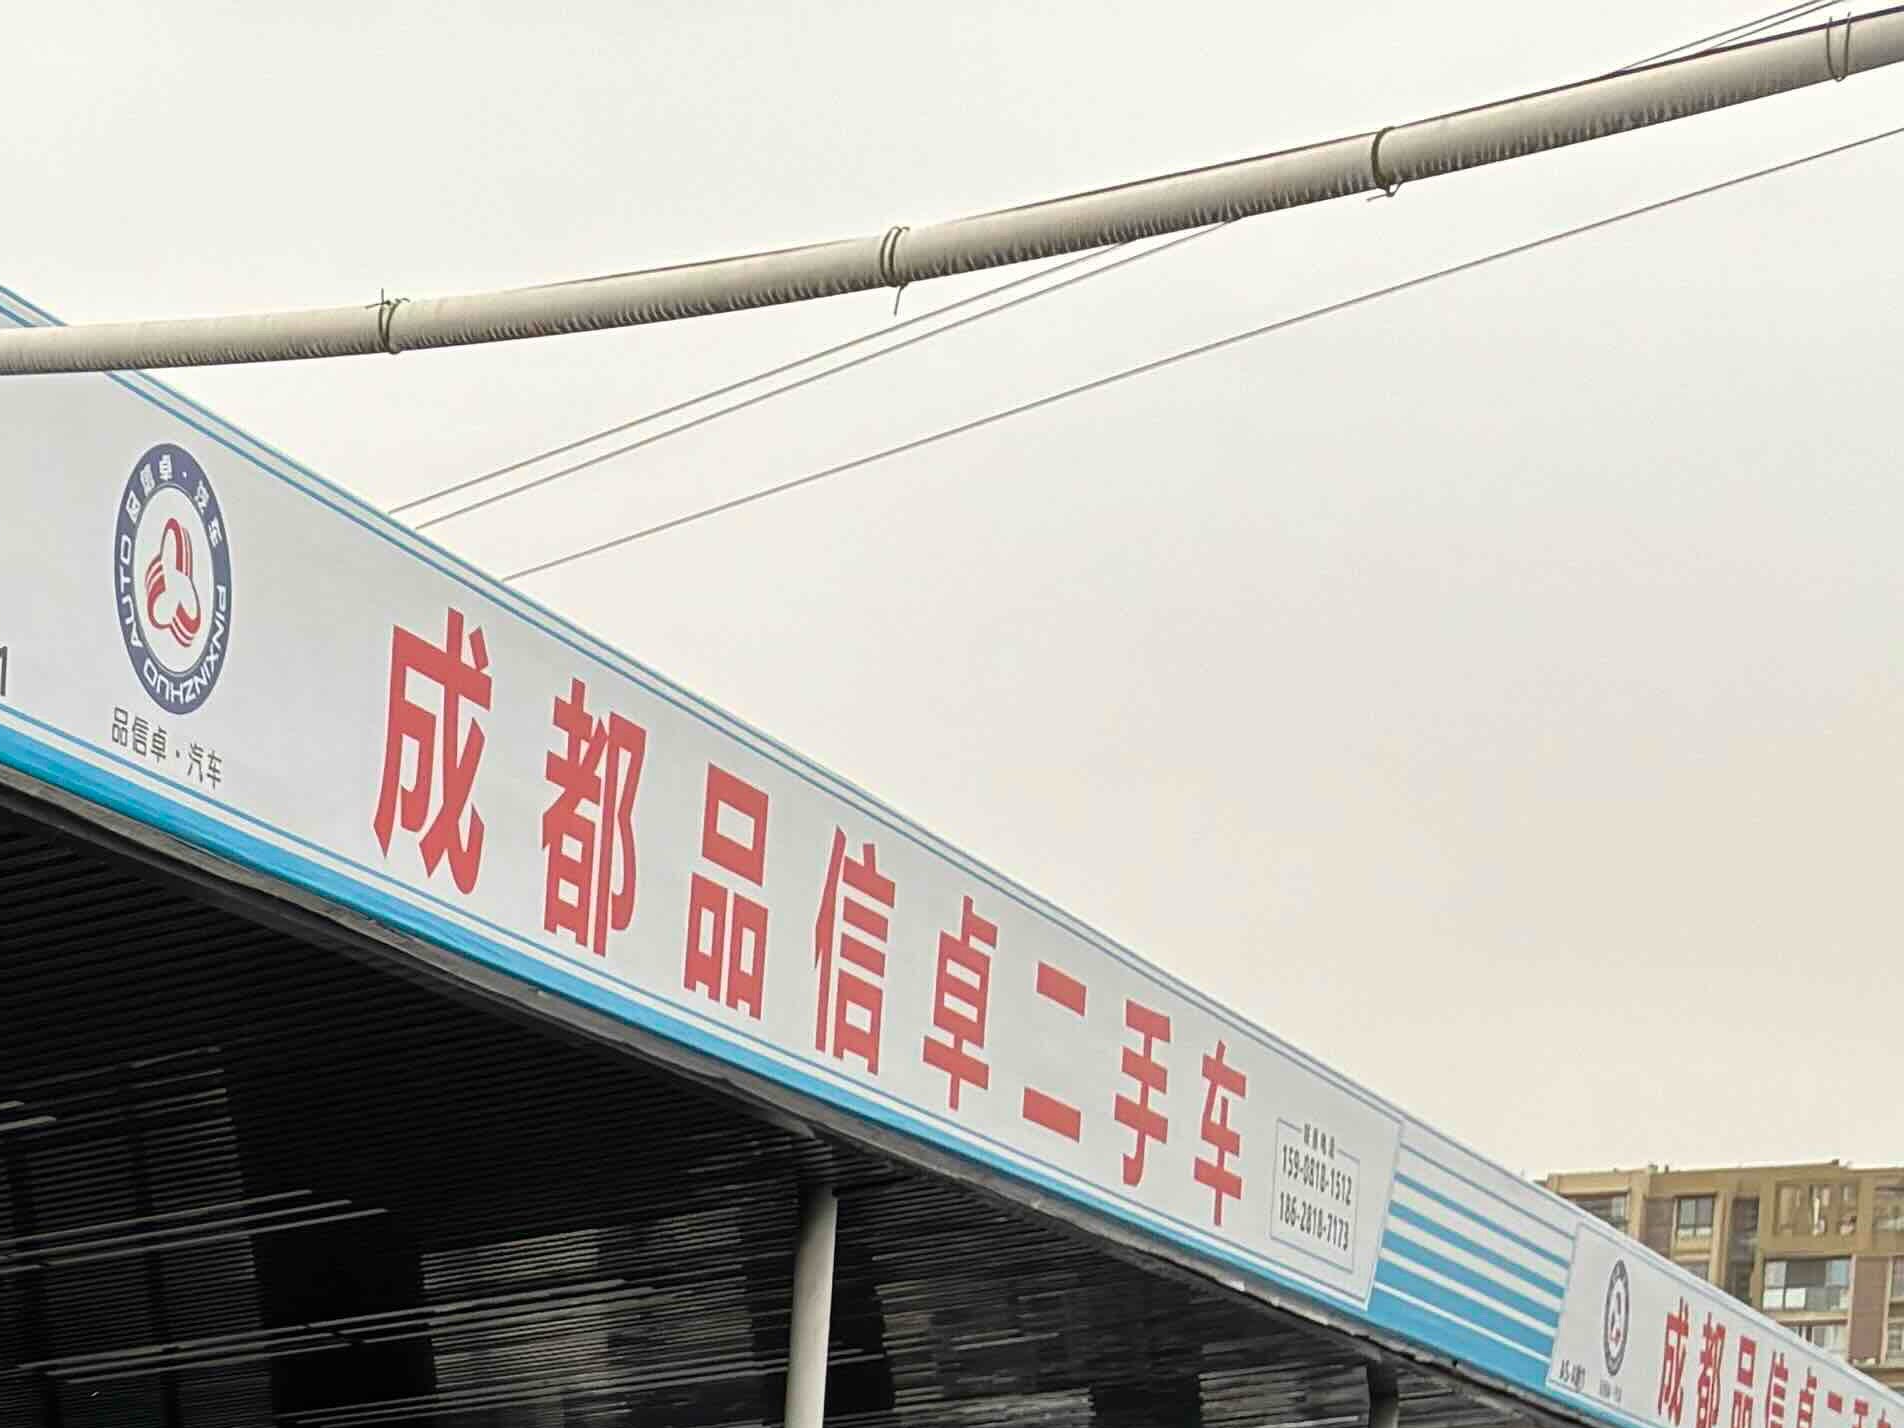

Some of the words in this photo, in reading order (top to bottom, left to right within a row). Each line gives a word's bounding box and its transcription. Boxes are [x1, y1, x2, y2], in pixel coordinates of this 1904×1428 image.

[373, 606, 1247, 1227] 成都品信卓二手车
